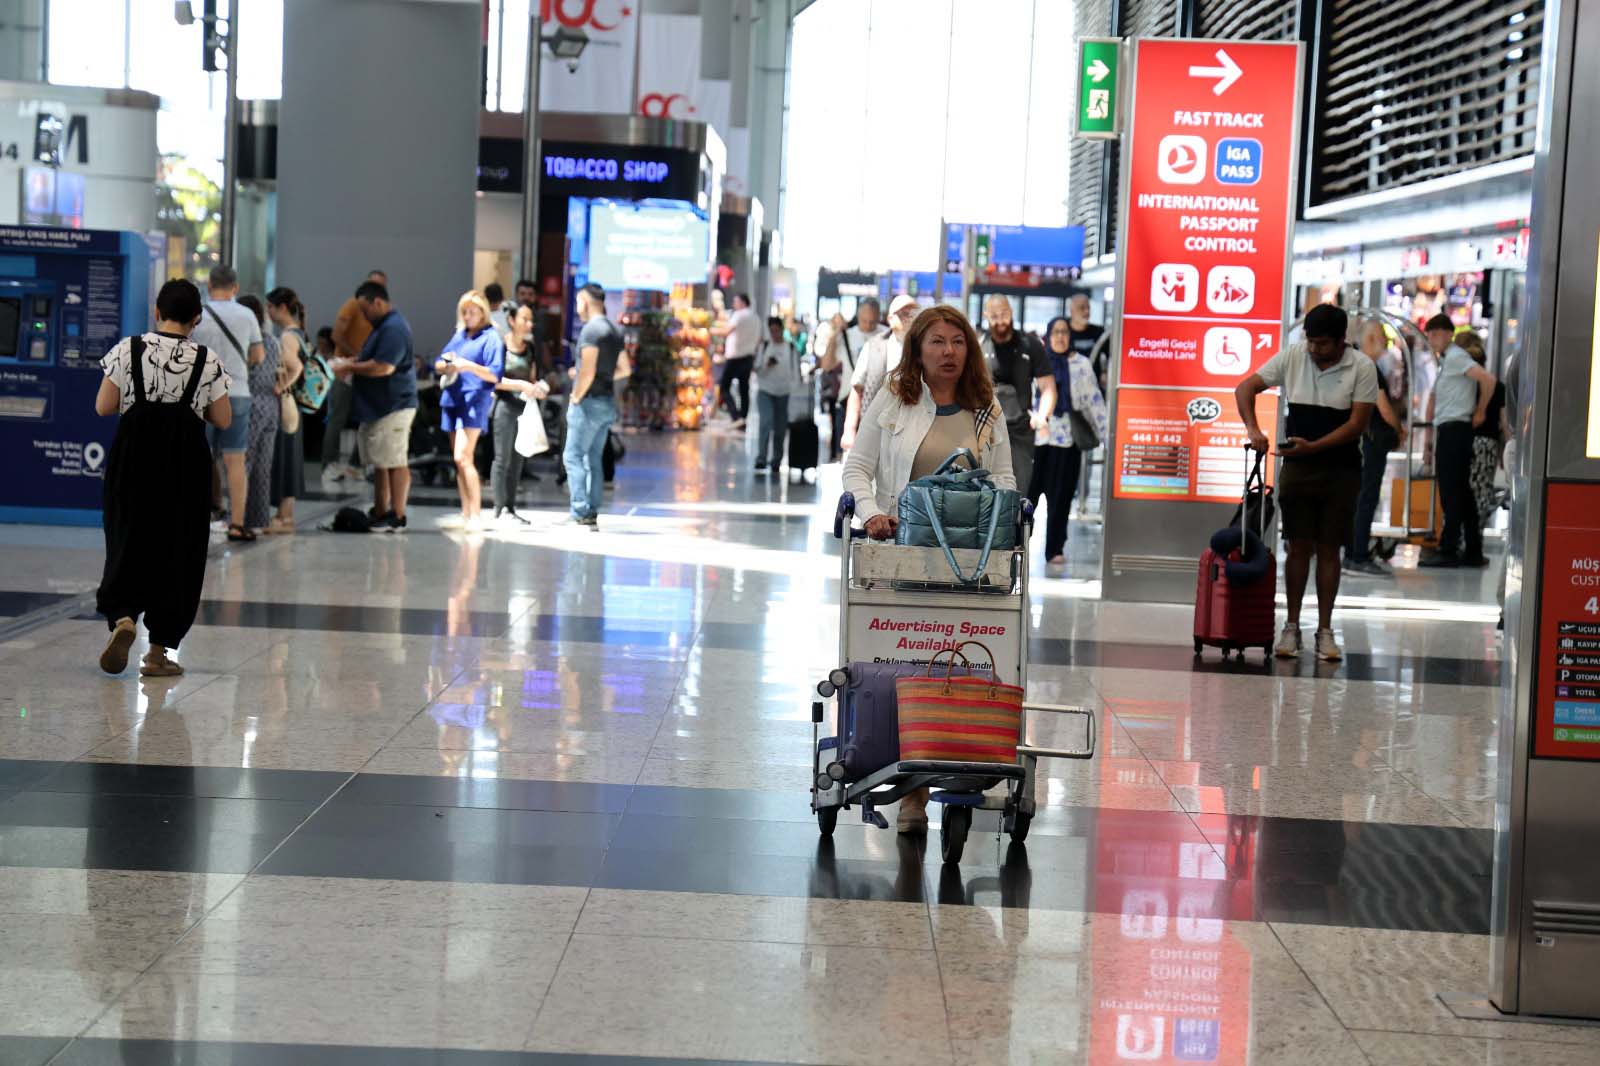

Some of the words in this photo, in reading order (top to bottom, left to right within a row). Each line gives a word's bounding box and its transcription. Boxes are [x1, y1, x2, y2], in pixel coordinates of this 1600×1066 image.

[1173, 110, 1210, 126] FAST
[1215, 112, 1264, 128] TRACK
[544, 156, 617, 181] TOBACCO
[623, 161, 669, 183] SHOP
[1220, 165, 1254, 178] PASS
[1138, 193, 1259, 212] INTERNATIONAL
[1179, 215, 1259, 232] PASSPORT
[1184, 236, 1257, 253] CONTROL
[1139, 337, 1169, 350] Engelli
[1128, 348, 1173, 360] Accessible
[1174, 350, 1197, 360] Lane
[1191, 404, 1217, 417] SOS
[868, 618, 955, 636] Advertising
[959, 621, 1006, 637] Space
[896, 636, 964, 651] Available
[1575, 689, 1597, 697] YOTEL
